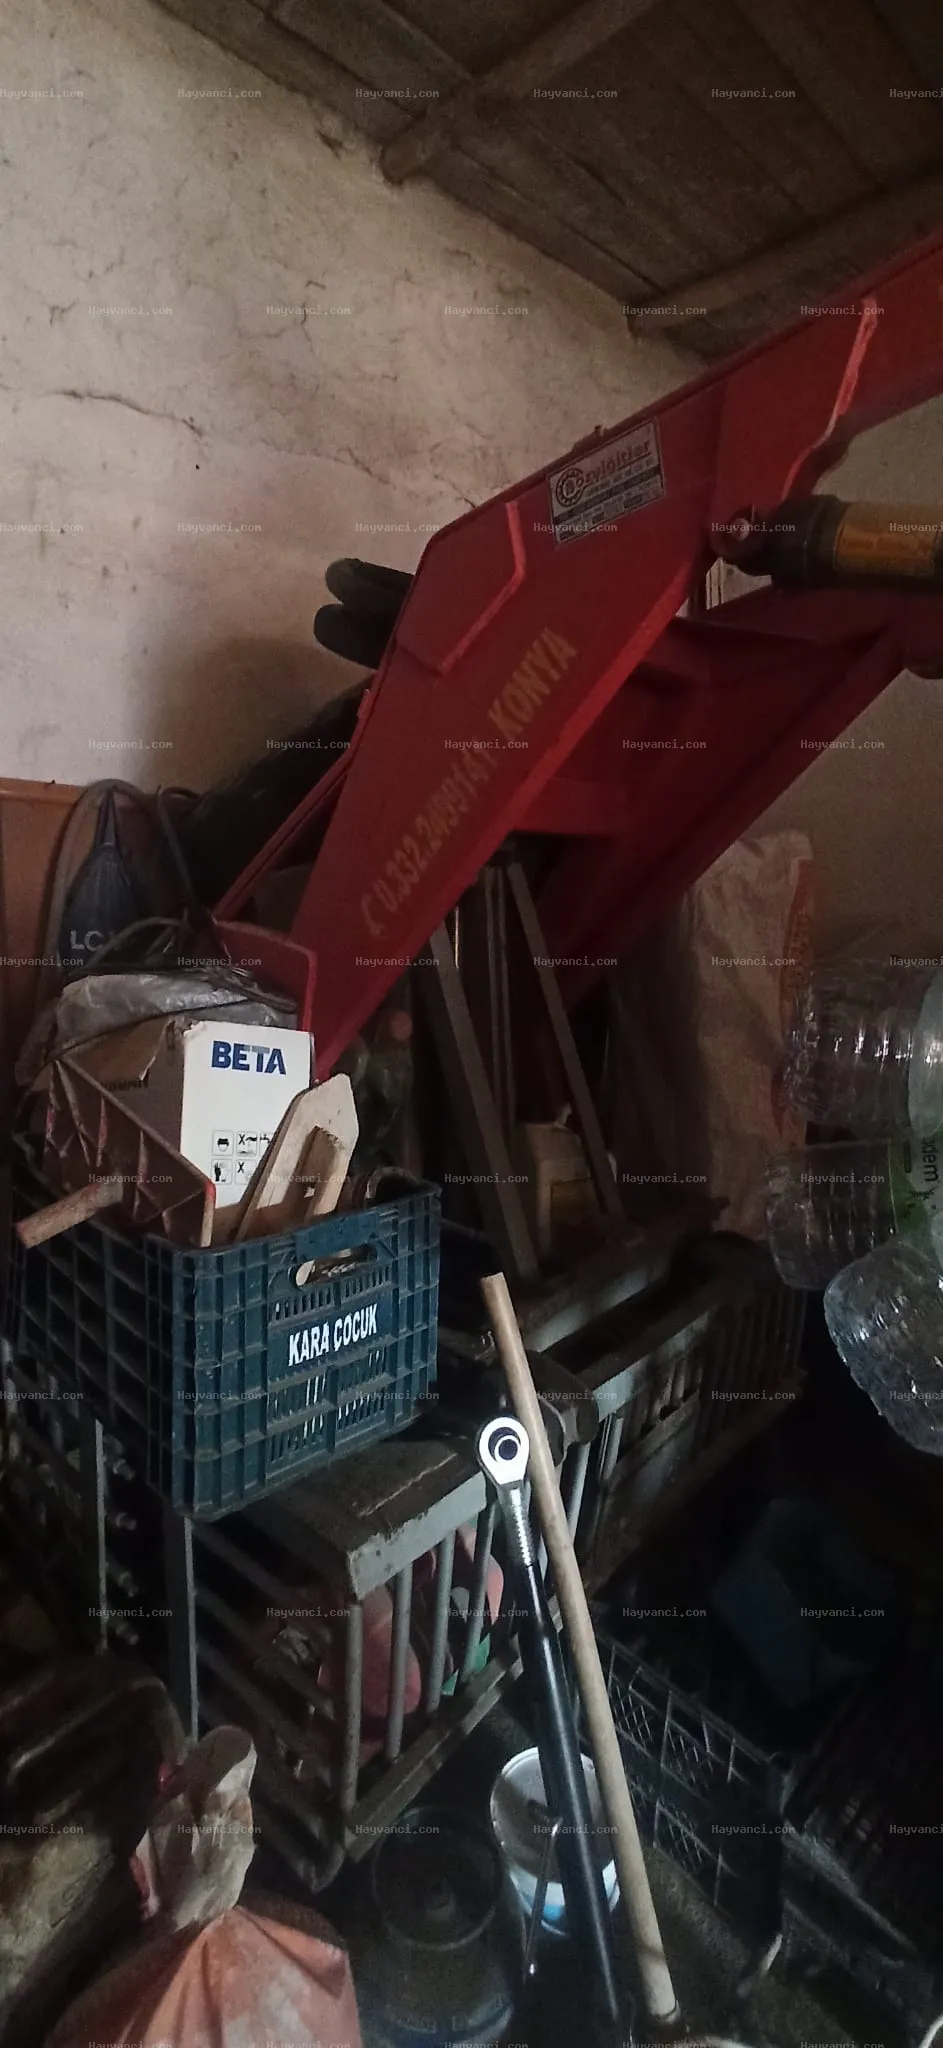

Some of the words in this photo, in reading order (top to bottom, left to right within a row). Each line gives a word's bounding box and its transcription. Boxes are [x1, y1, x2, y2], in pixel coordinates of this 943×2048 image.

[487, 626, 580, 741] KONYA
[70, 930, 104, 952] LC
[211, 1040, 287, 1075] BETA
[288, 1321, 330, 1367] KARA
[333, 1303, 378, 1352] ÇOCUK
